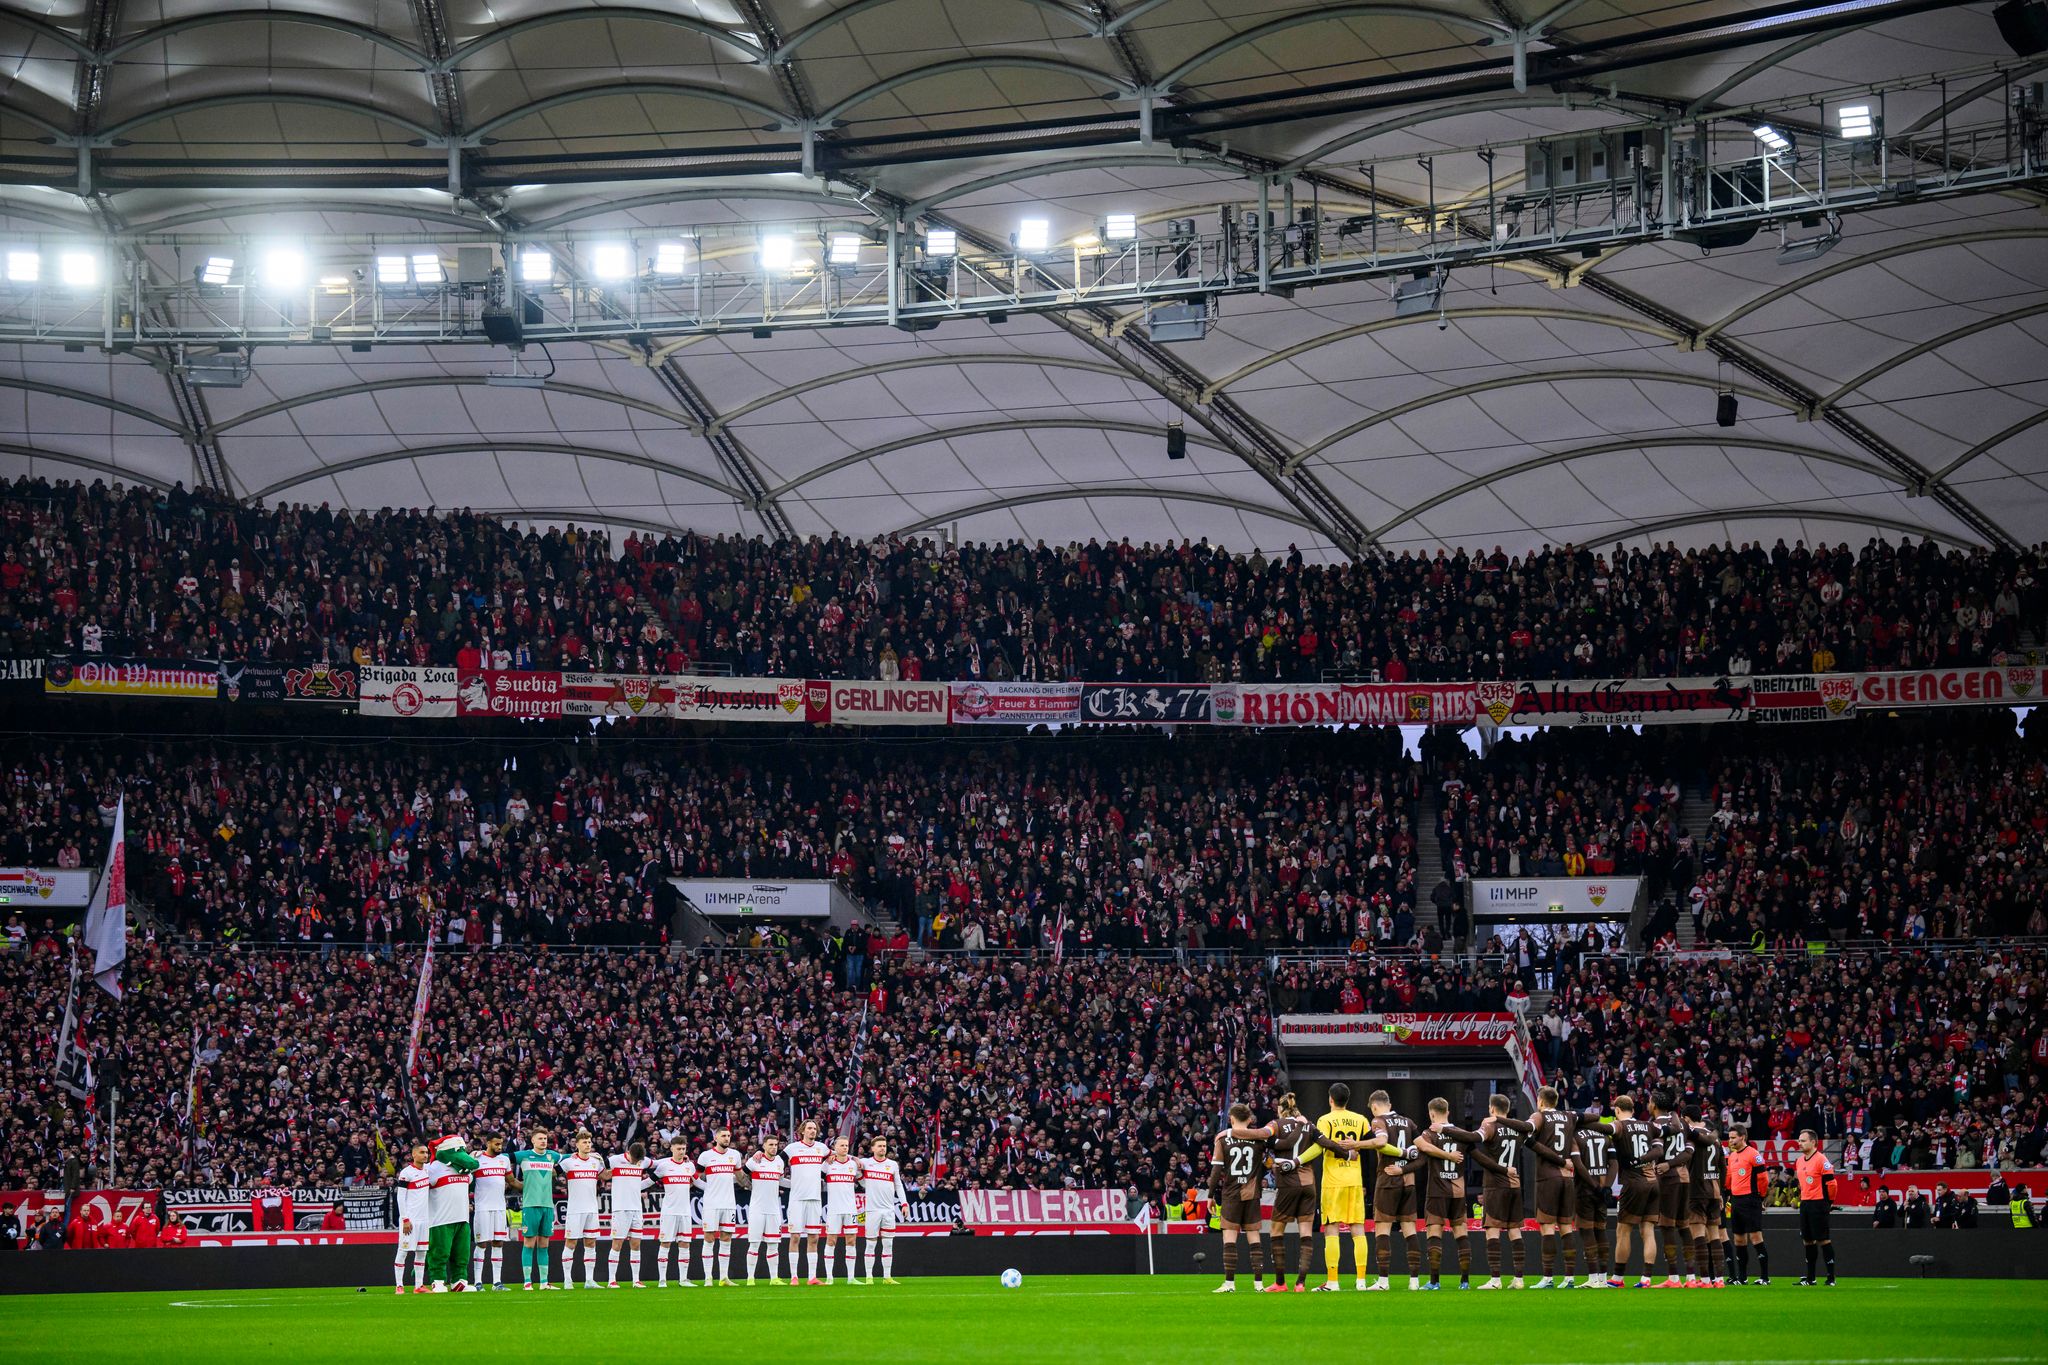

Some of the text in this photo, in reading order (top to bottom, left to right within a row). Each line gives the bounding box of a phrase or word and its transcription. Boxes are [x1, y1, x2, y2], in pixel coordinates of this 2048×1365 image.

[80, 661, 118, 687] Old
[123, 662, 218, 690] Warriors
[360, 667, 456, 685] Brigada Loca
[495, 675, 558, 694] Suebia
[625, 679, 649, 695] VfB
[779, 684, 804, 698] VfB
[999, 686, 1041, 694] BACKNANG
[1754, 676, 1817, 693] BRENZTAL
[1862, 671, 2002, 702] GIENGEN
[491, 695, 561, 717] Ehingen
[566, 702, 593, 713] Garde
[694, 685, 779, 713] Hessen
[835, 688, 943, 713] GERLINGEN
[999, 699, 1079, 709] Feuer & Flamme
[1242, 692, 1340, 723] RHÖN
[1343, 691, 1476, 722] DONAU RIES
[1514, 681, 1701, 719] Alte Garde
[1000, 712, 1045, 720] CANNSTATT
[1578, 713, 1642, 725] Stuttgart
[1755, 706, 1827, 722] SCHWABEN
[719, 893, 781, 905] MHP Arena
[1506, 888, 1538, 900] MHP
[1345, 1022, 1379, 1034] 1893
[1421, 1012, 1453, 1041] till
[1478, 1013, 1507, 1041] die
[1343, 1118, 1358, 1128] PAULI
[1635, 1123, 1649, 1133] PAULI
[1497, 1127, 1507, 1137] ST.
[1554, 1123, 1565, 1151] 5
[1578, 1130, 1589, 1139] ST.
[1498, 1139, 1516, 1168] 21
[1586, 1138, 1606, 1168] 17
[1631, 1134, 1649, 1160] 16
[1229, 1146, 1254, 1176] 23
[1442, 1142, 1458, 1172] 11
[1706, 1144, 1716, 1172] 2
[711, 1165, 734, 1173] WINAMAX
[867, 1171, 891, 1180] WINAMAX
[163, 1188, 252, 1204] SCHWABE
